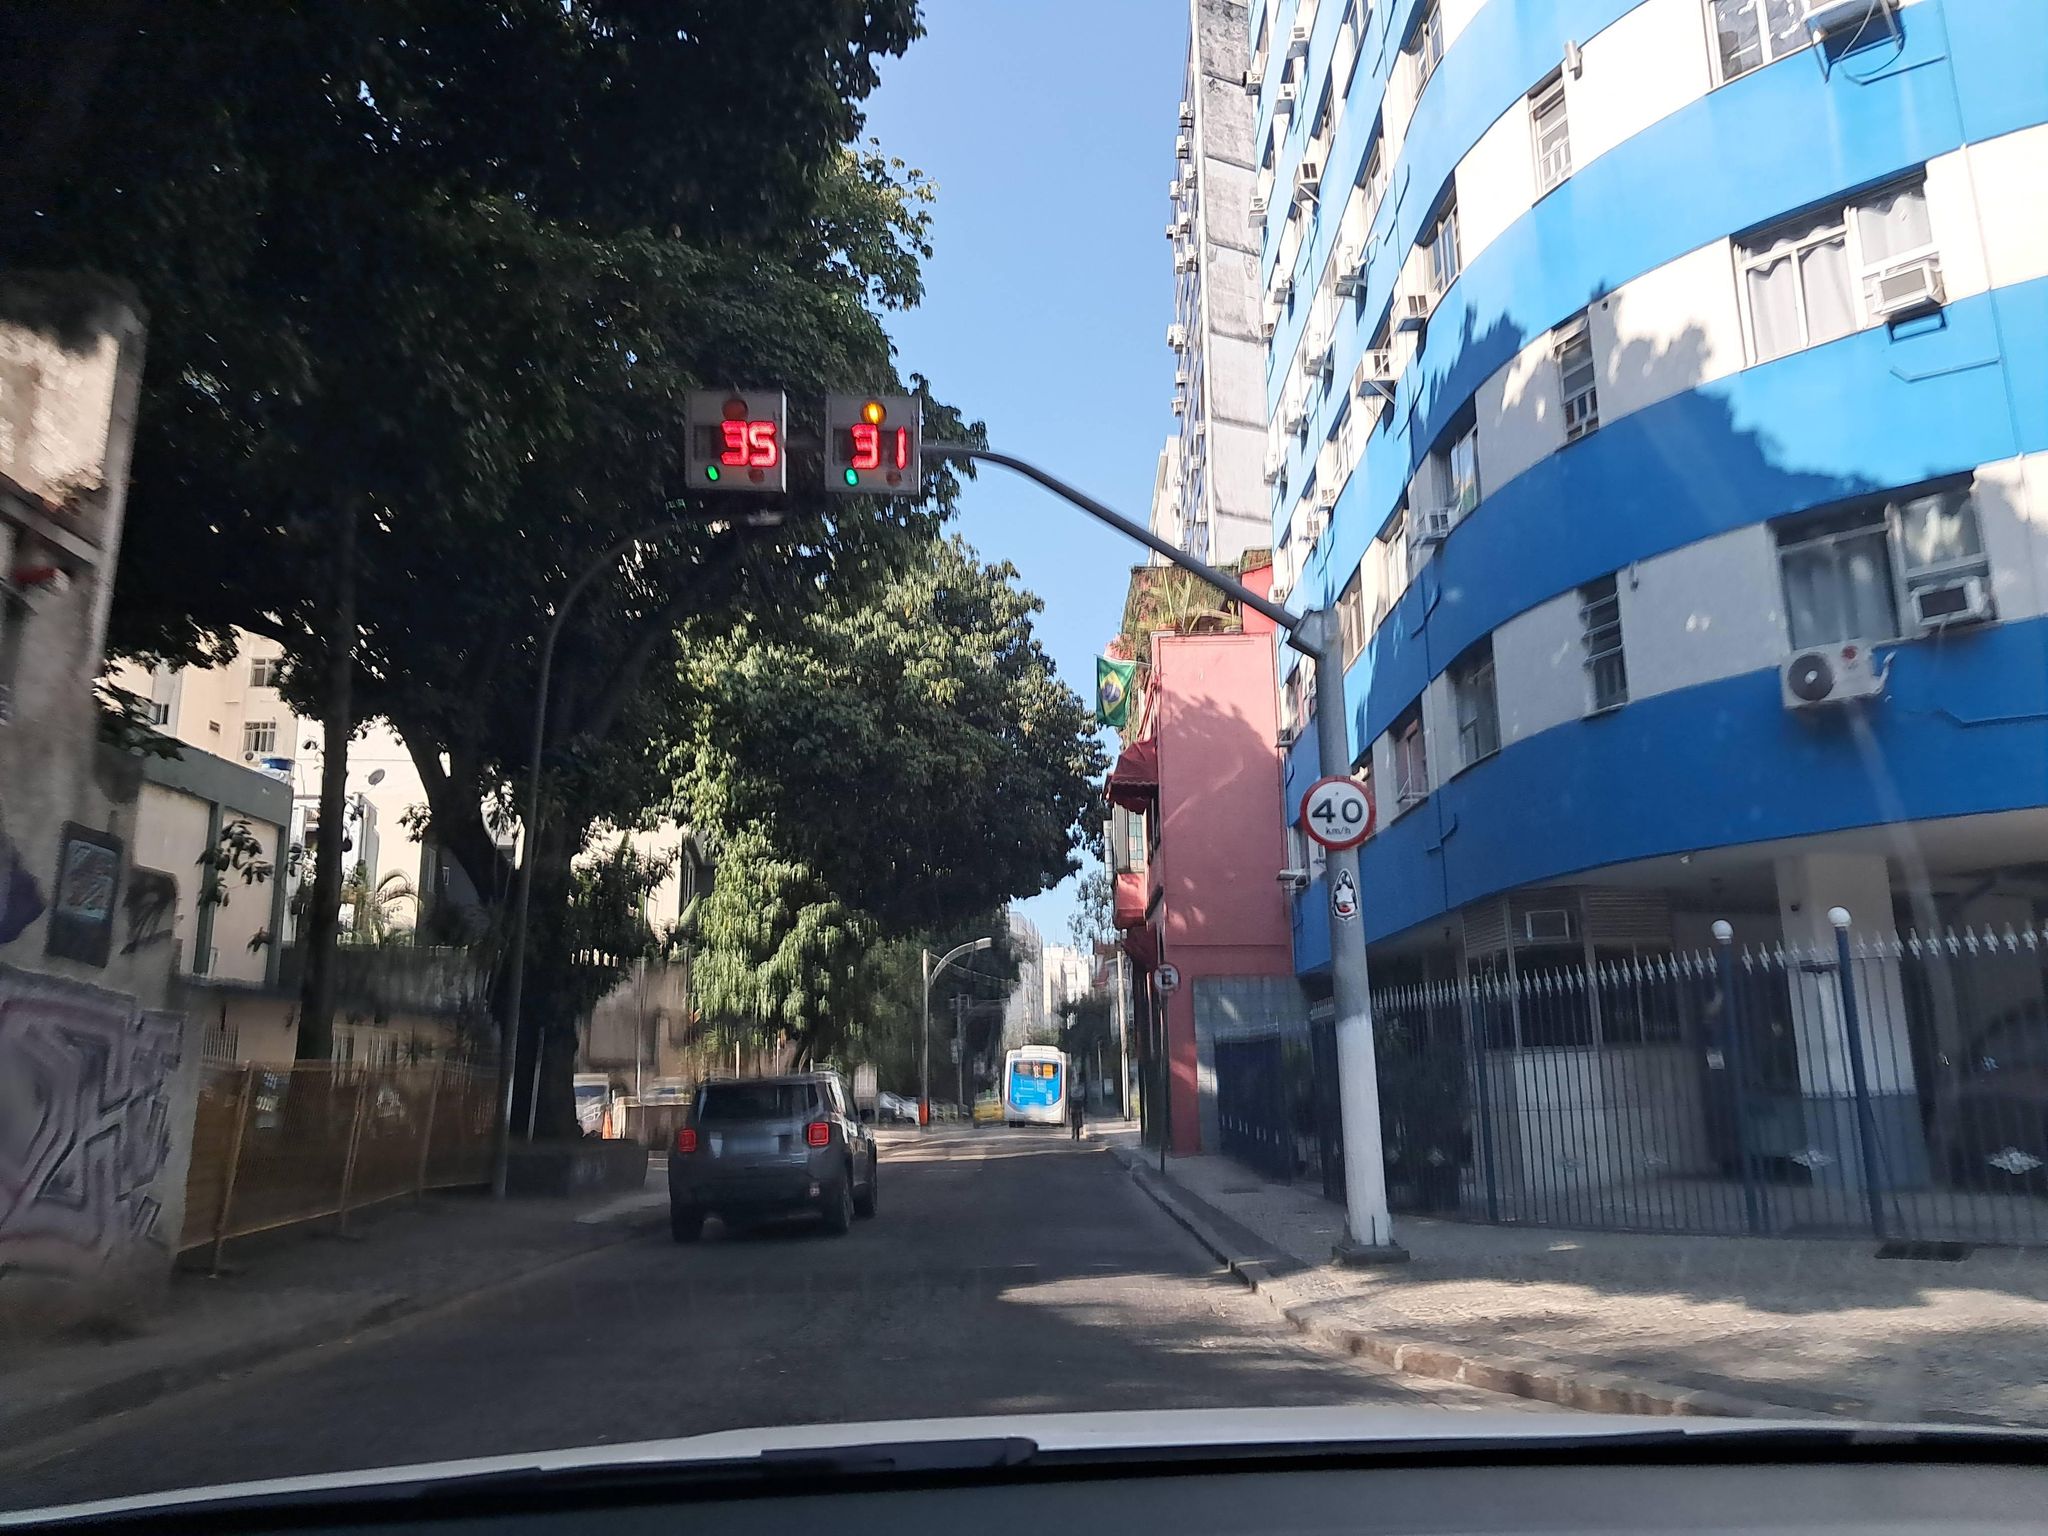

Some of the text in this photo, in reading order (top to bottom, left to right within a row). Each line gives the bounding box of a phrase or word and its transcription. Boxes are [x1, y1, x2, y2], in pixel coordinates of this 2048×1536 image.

[721, 420, 777, 467] 35
[851, 423, 906, 470] 31
[1312, 798, 1363, 823] 40
[1325, 826, 1351, 835] km/h
